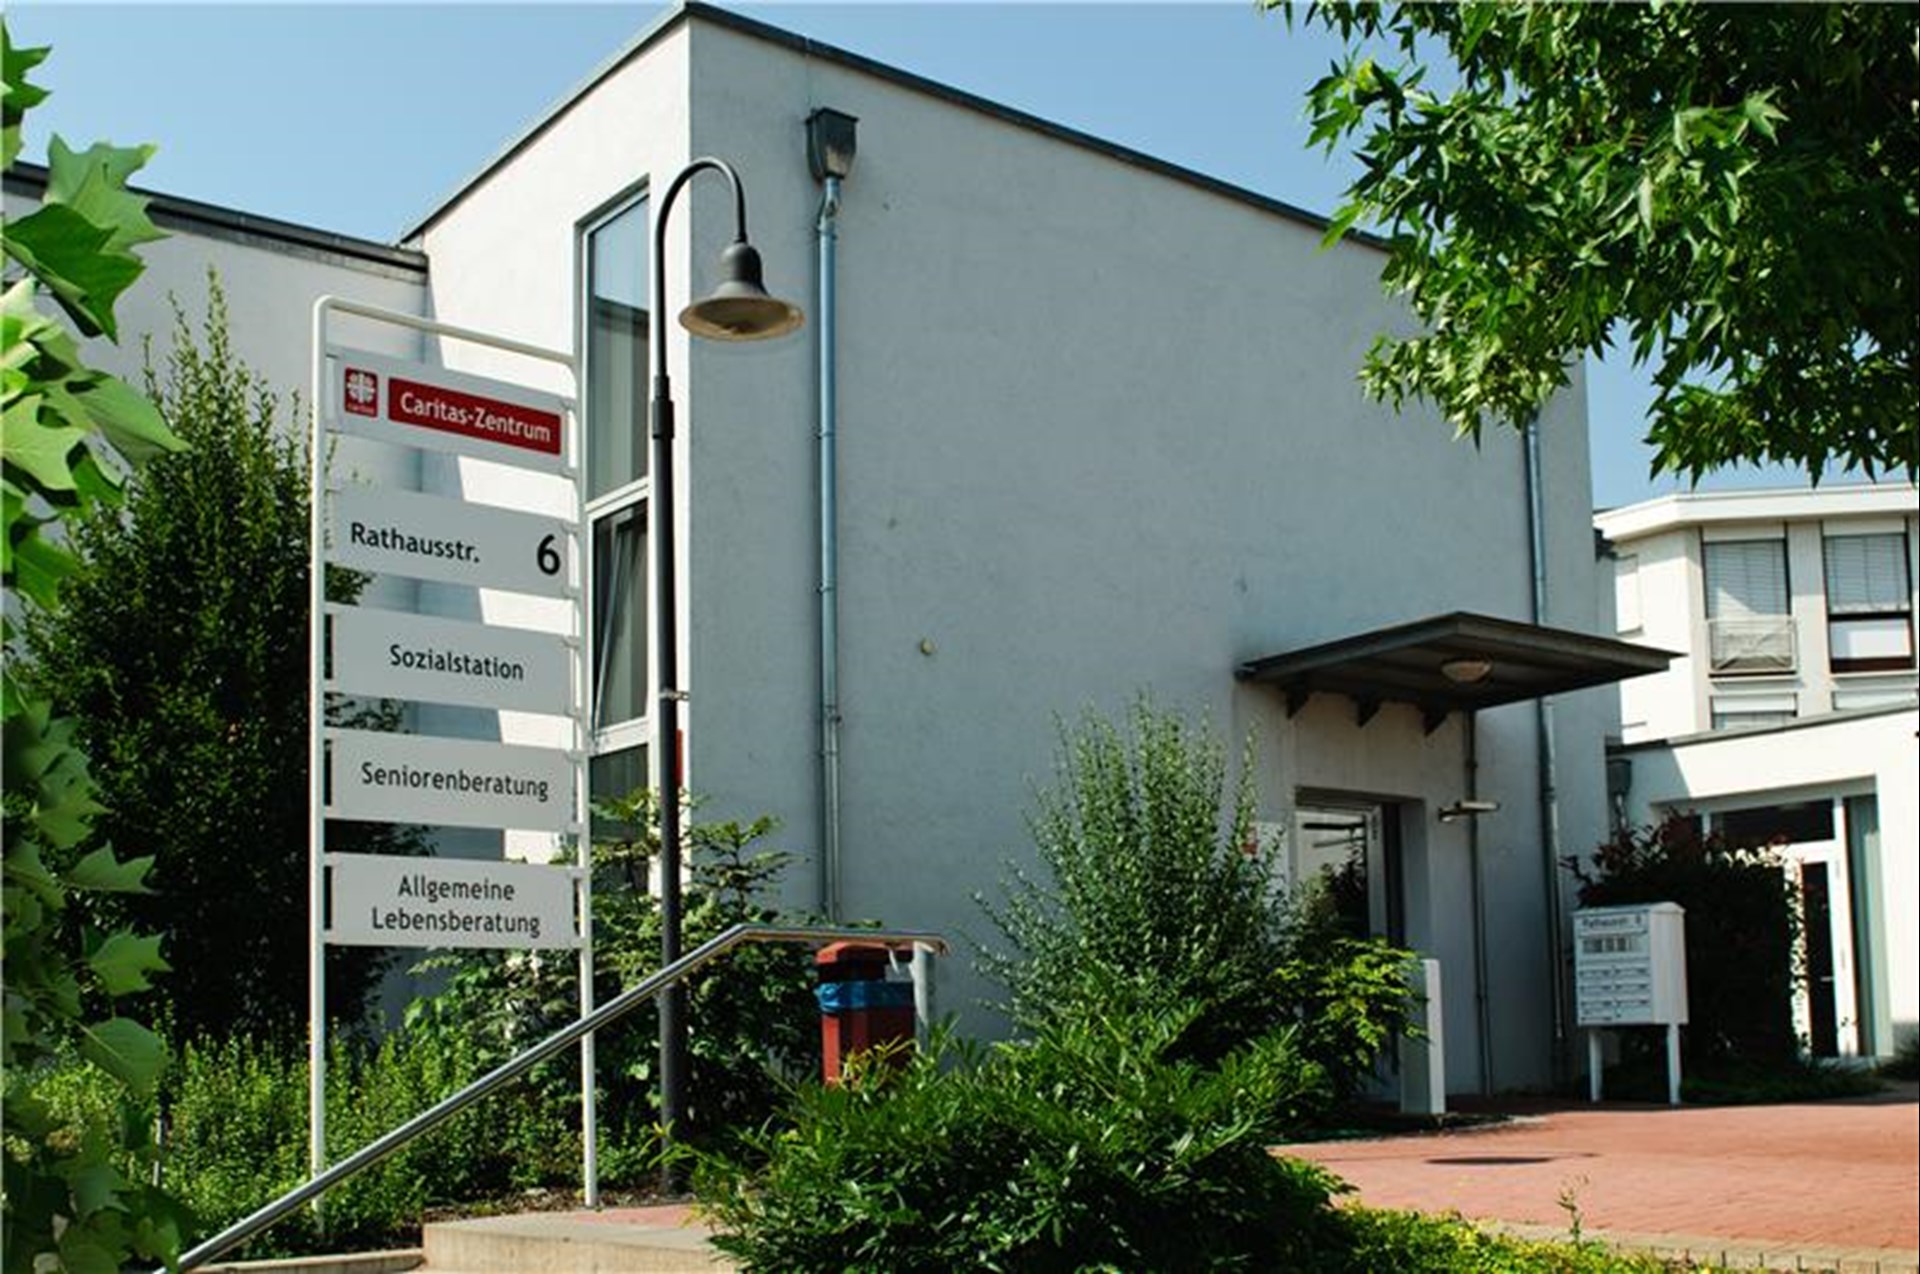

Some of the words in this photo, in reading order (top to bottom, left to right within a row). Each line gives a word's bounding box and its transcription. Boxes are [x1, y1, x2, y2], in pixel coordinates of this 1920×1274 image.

[400, 392, 550, 442] Caritas-Zentrum
[351, 522, 480, 564] Rathausstr.
[536, 533, 561, 576] 6
[390, 644, 524, 680] Sozialstation
[361, 762, 549, 802] Seniorenberatung
[398, 875, 515, 903] Allgemeine
[372, 907, 540, 938] Lebensberatung
